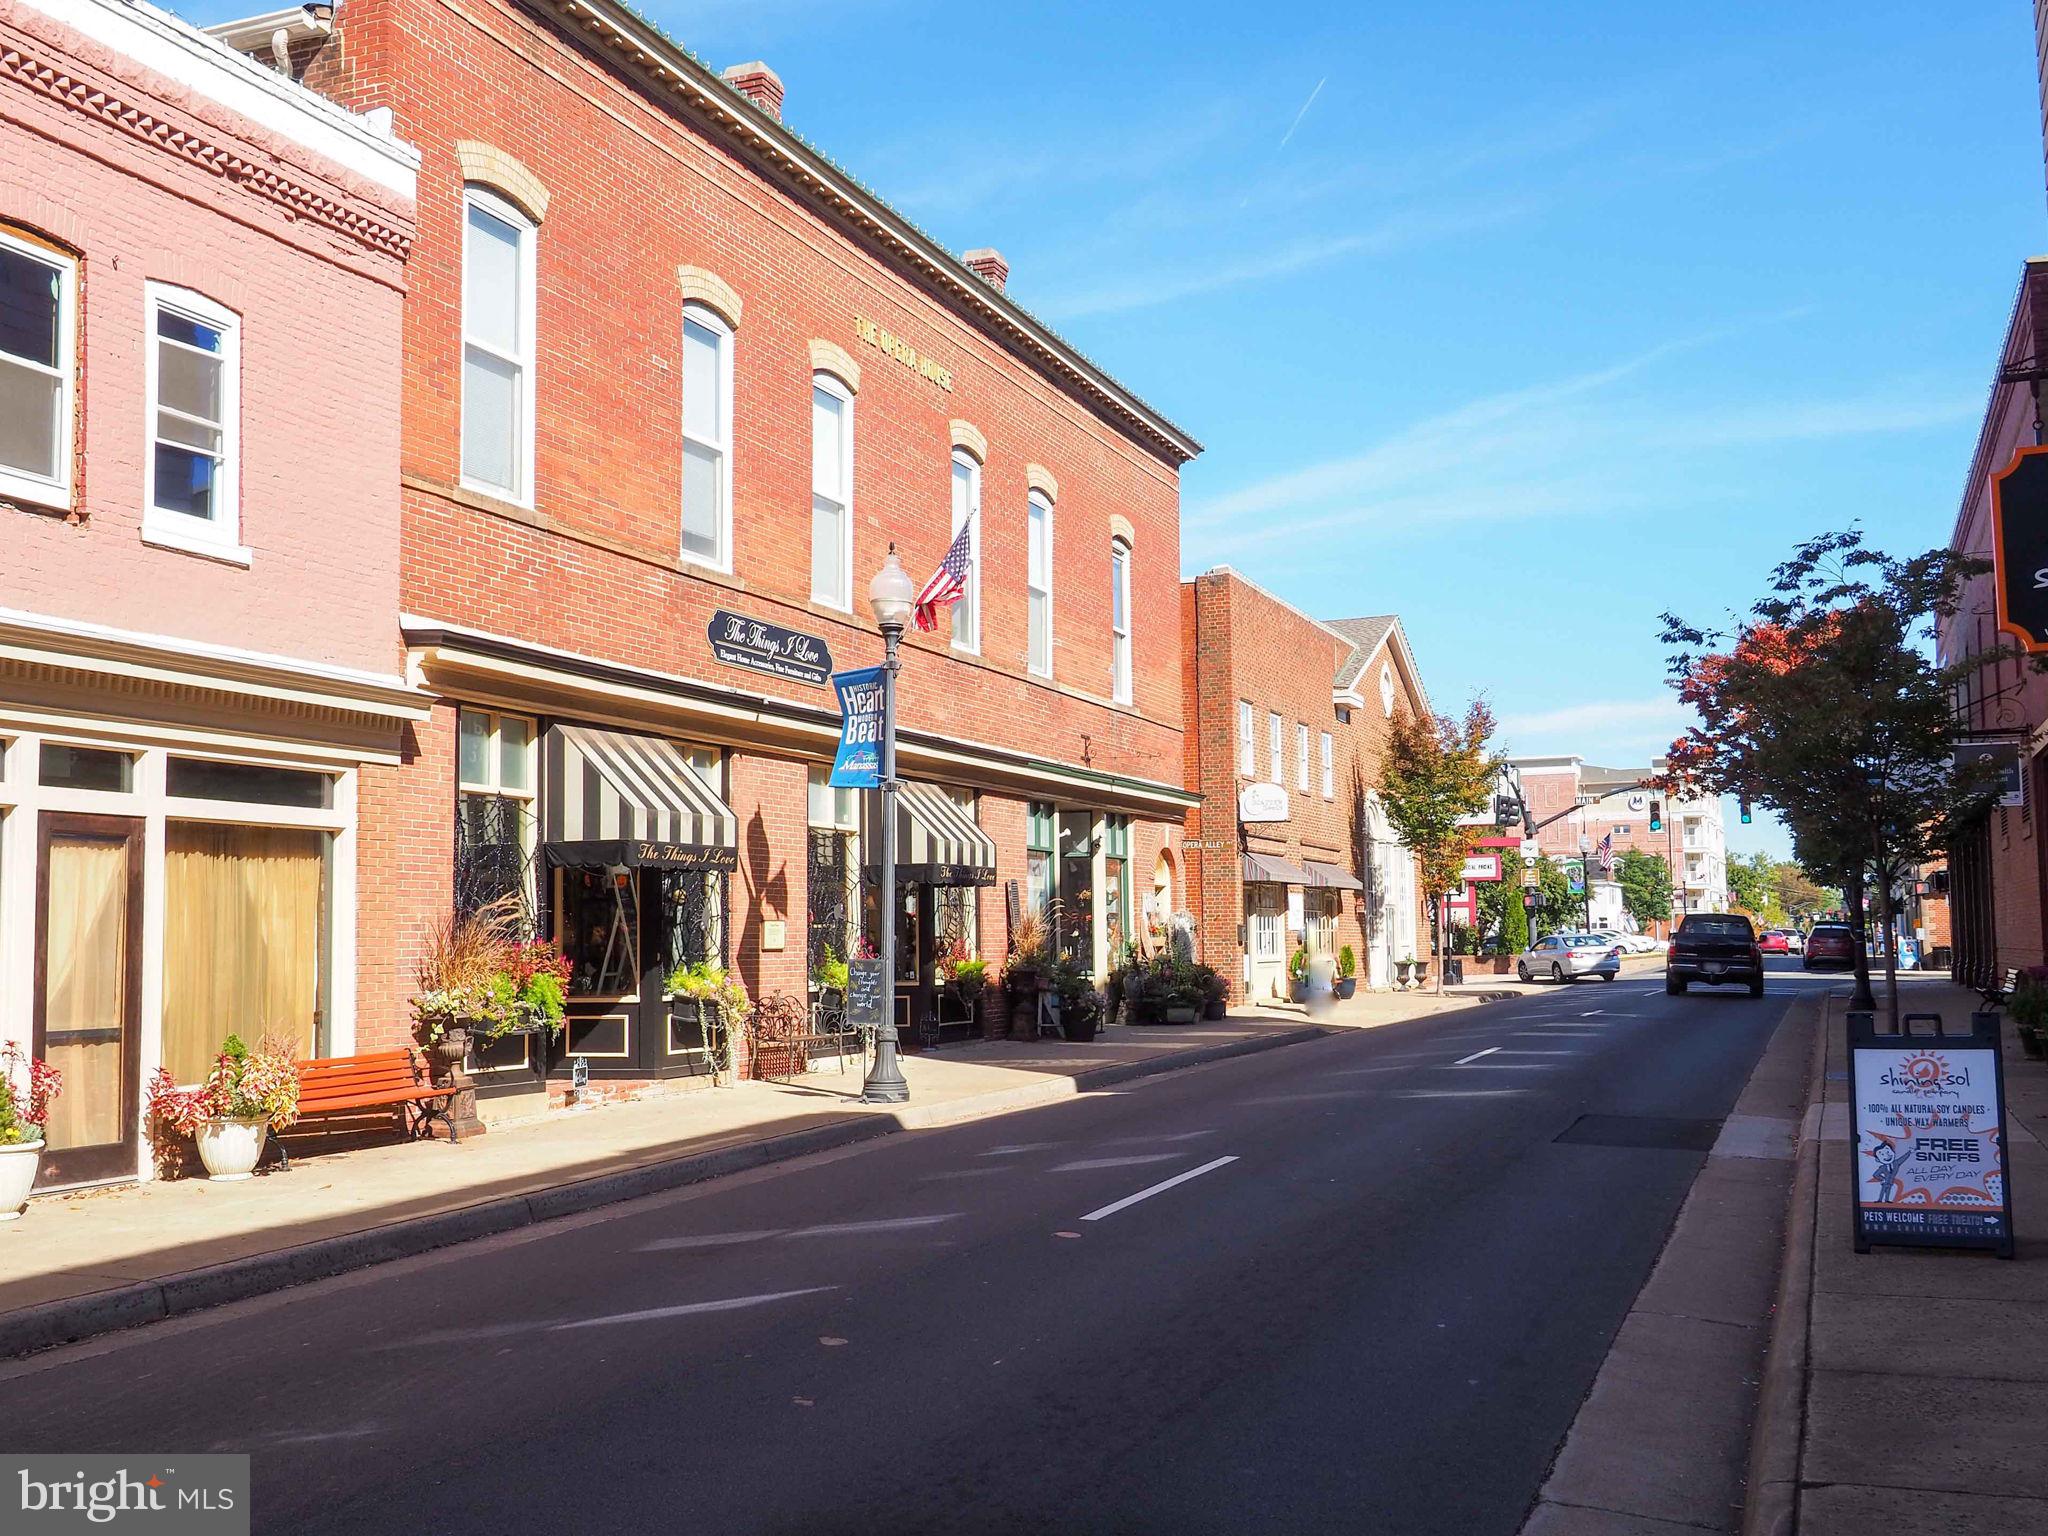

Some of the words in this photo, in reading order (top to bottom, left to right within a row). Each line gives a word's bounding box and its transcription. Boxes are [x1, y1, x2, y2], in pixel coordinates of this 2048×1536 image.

[855, 316, 877, 347] THE
[880, 328, 916, 371] OPERA
[919, 353, 952, 393] HOUSE
[724, 616, 746, 643] The
[747, 622, 780, 660] Things
[794, 636, 819, 663] Love
[737, 653, 750, 664] Home
[852, 682, 878, 692] HISTORIC
[841, 686, 885, 715] Heart
[845, 715, 884, 745] Beat
[1575, 796, 1593, 805] MAIN
[1181, 841, 1202, 849] OPERA
[1206, 841, 1224, 849] ALLEY
[638, 843, 660, 860] The
[661, 844, 697, 867] Things
[710, 848, 735, 864] Love
[940, 865, 953, 878] The
[981, 868, 995, 881] Love
[1880, 1067, 1942, 1090] shining
[1946, 1067, 1970, 1086] sol
[1868, 1103, 1888, 1114] 100%
[1891, 1104, 1903, 1113] ALL
[1904, 1104, 1935, 1114] NATURAL
[1936, 1104, 1950, 1114] SOY
[1952, 1105, 1985, 1114] CANDLES
[1885, 1117, 1912, 1127] UNIQUE
[1915, 1117, 1930, 1127] WAX
[1933, 1117, 1969, 1127] WARMERS
[1915, 1138, 1980, 1152] FREE
[1915, 1152, 1980, 1163] SNIFFS
[1906, 1167, 1926, 1175] ALL
[1930, 1165, 1956, 1173] DAY
[1914, 1173, 1954, 1183] EVERY
[1955, 1170, 1982, 1179] DAY
[1864, 1211, 1884, 1222] PETS
[1886, 1212, 1925, 1223] WELCOME
[1928, 1214, 1949, 1225] FREE
